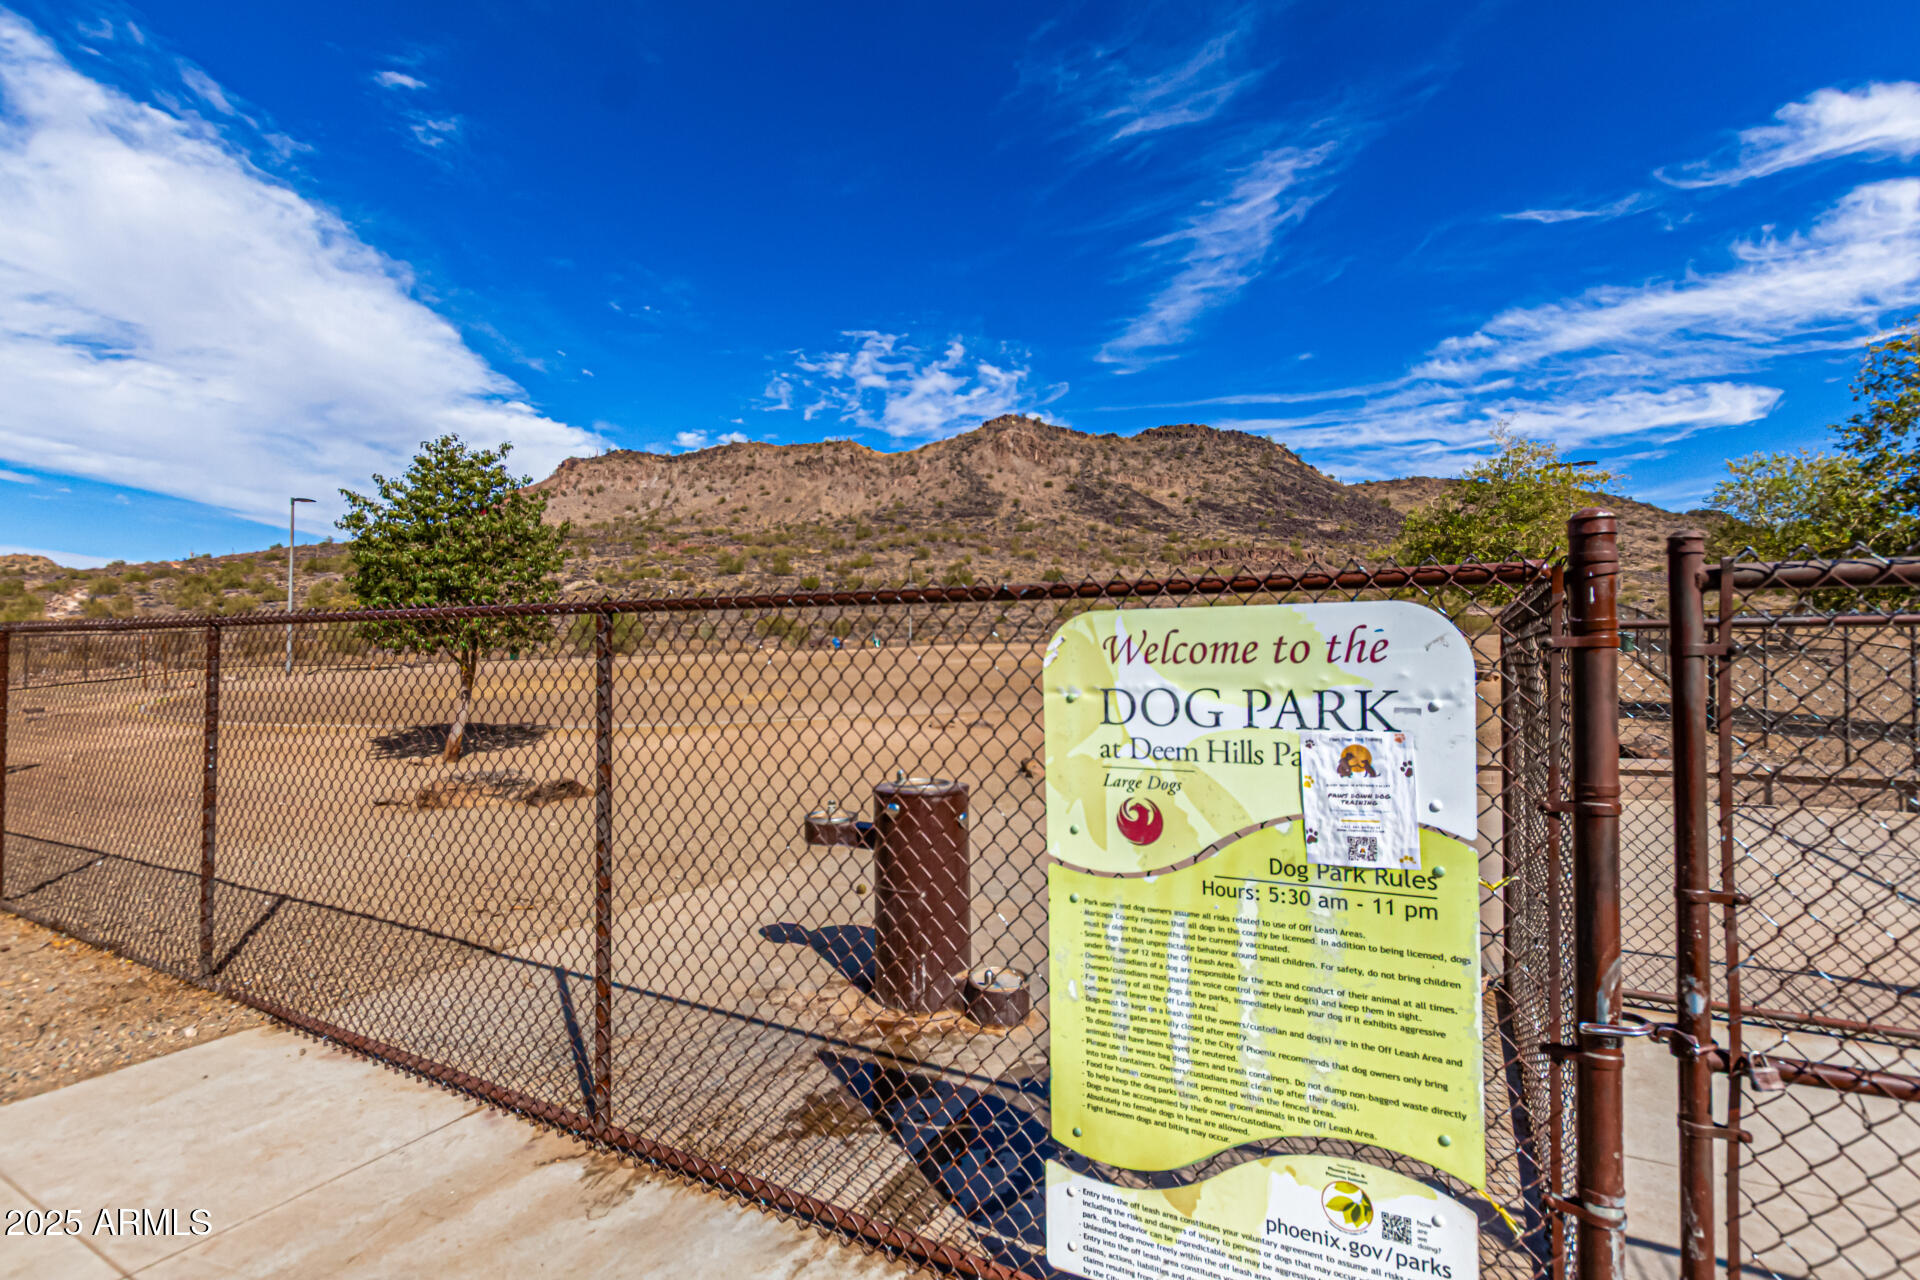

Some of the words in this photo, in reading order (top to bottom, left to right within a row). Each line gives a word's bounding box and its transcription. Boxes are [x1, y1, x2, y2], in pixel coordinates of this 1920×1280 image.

[1102, 628, 1259, 666] Welcome
[1273, 634, 1311, 664] to
[1326, 624, 1389, 664] the
[1100, 687, 1223, 729] DOG
[1242, 688, 1402, 733] PARK
[1100, 741, 1121, 760] at
[1130, 736, 1199, 763] Deem
[1207, 738, 1264, 767] Hills
[1103, 773, 1142, 793] Large
[1148, 775, 1182, 794] Dogs
[1269, 858, 1309, 882] Dog
[1317, 864, 1366, 884] Park
[1375, 868, 1438, 891] Rules
[1084, 898, 1098, 906] Park
[1119, 902, 1131, 910] and
[1133, 904, 1145, 913] dog
[1148, 907, 1172, 915] owners
[1174, 910, 1200, 918] assume
[1213, 914, 1230, 922] risks
[1232, 917, 1260, 926] related
[1299, 924, 1312, 932] Off
[1314, 925, 1338, 935] Leash
[1340, 929, 1366, 939] Areas.
[1202, 880, 1260, 901] Hours:
[1269, 886, 1311, 906] 5:30
[1318, 895, 1348, 911] am
[1373, 898, 1394, 916] 11
[1405, 904, 1438, 921] pm
[1084, 920, 1100, 928] must
[1112, 923, 1129, 932] older
[1131, 926, 1147, 934] than
[1155, 930, 1181, 939] months
[1183, 933, 1196, 941] and
[1197, 934, 1207, 942] be
[1209, 937, 1243, 948] currently
[1245, 942, 1290, 953] vaccinated.
[1116, 913, 1138, 923] County
[1141, 917, 1169, 926] requires
[1171, 920, 1185, 928] that
[1199, 923, 1216, 932] dogs
[1227, 926, 1240, 934] the
[1242, 929, 1268, 939] county
[1282, 934, 1318, 945] licensed.
[1331, 941, 1366, 951] addition
[1368, 945, 1378, 953] to
[1380, 946, 1404, 958] being
[1407, 949, 1447, 962] licensed,
[1450, 955, 1472, 966] dogs
[1084, 931, 1102, 939] Some
[1104, 933, 1119, 942] dogs
[1121, 936, 1144, 945] exhibit
[1146, 939, 1195, 951] unpredictable
[1197, 946, 1228, 956] behavior
[1231, 951, 1257, 960] around
[1259, 955, 1280, 963] small
[1282, 958, 1318, 969] children.
[1321, 962, 1334, 971] For
[1337, 965, 1364, 977] safety,
[1368, 969, 1378, 978] do
[1381, 972, 1395, 980] not
[1398, 973, 1421, 985] bring
[1424, 977, 1461, 989] children
[1194, 969, 1235, 981] responsible
[1238, 974, 1248, 982] for
[1266, 980, 1282, 988] acts
[1285, 981, 1300, 990] and
[1302, 984, 1335, 995] conduct
[1337, 989, 1345, 997] of
[1348, 991, 1368, 1000] their
[1371, 995, 1400, 1005] animal
[1403, 1000, 1412, 1008] at
[1415, 1001, 1426, 1010] all
[1429, 1003, 1458, 1015] times.
[1253, 989, 1269, 997] over
[1272, 991, 1291, 999] their
[1294, 995, 1319, 1005] dog(s)
[1321, 999, 1336, 1008] and
[1339, 1001, 1359, 1012] keep
[1362, 1005, 1384, 1015] them
[1387, 1009, 1395, 1017] in
[1397, 1011, 1422, 1022] sight.
[1234, 997, 1282, 1012] immediately
[1284, 1005, 1304, 1015] leash
[1307, 1009, 1325, 1018] your
[1327, 1012, 1343, 1022] dog
[1354, 1016, 1360, 1024] it
[1363, 1019, 1397, 1030] exhibits
[1400, 1025, 1447, 1038] aggressive
[1246, 1045, 1276, 1058] Phoenix
[1278, 1053, 1330, 1068] recommends
[1332, 1062, 1349, 1072] that
[1352, 1066, 1367, 1077] dog
[1370, 1070, 1400, 1081] owners
[1403, 1075, 1422, 1087] only
[1424, 1079, 1449, 1092] bring
[1378, 1045, 1392, 1055] Off
[1394, 1047, 1420, 1059] Leash
[1422, 1053, 1443, 1064] Area
[1446, 1058, 1463, 1067] and
[1248, 1070, 1292, 1085] containers.
[1295, 1079, 1306, 1088] Do
[1308, 1081, 1321, 1090] not
[1324, 1085, 1347, 1097] dump
[1402, 1102, 1429, 1112] waste
[1431, 1106, 1467, 1122] directly
[1282, 1100, 1310, 1113] fenced
[1312, 1108, 1337, 1119] areas.
[1082, 1188, 1100, 1200] Entry
[1102, 1194, 1115, 1203] into
[1116, 1198, 1129, 1207] the
[1130, 1202, 1140, 1211] off
[1142, 1205, 1161, 1216] leash
[1162, 1212, 1178, 1221] area
[1180, 1216, 1221, 1233] constitutes
[1222, 1227, 1239, 1237] your
[1241, 1233, 1278, 1249] voluntary
[1280, 1243, 1323, 1260] agreement
[1326, 1255, 1335, 1264] to
[1337, 1260, 1368, 1272] assume
[1371, 1268, 1381, 1277] all
[1266, 1218, 1452, 1280] phoenix.gov/parks
